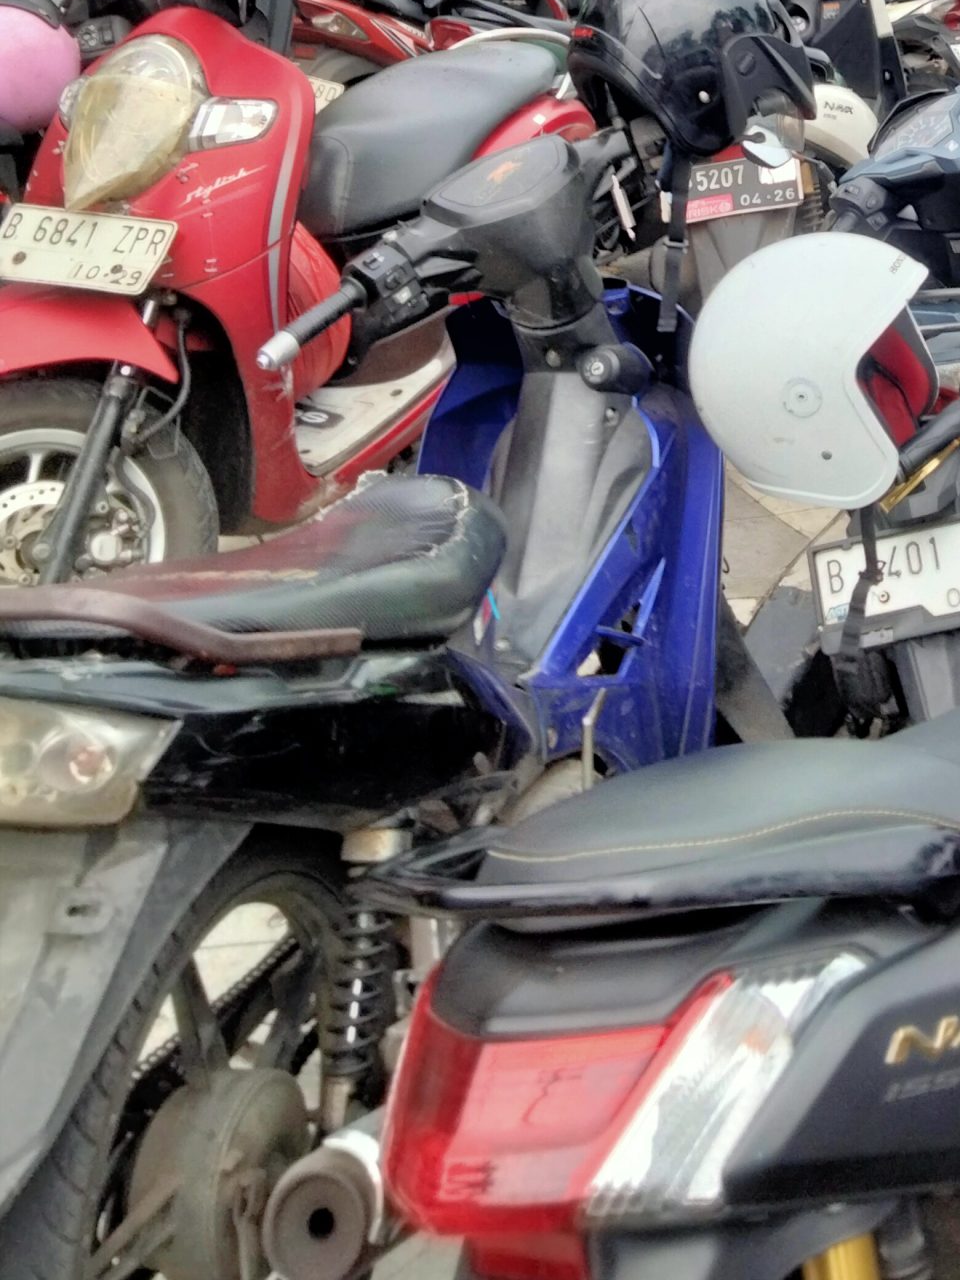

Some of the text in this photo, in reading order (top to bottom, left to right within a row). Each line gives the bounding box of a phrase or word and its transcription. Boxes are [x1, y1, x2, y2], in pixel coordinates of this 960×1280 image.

[696, 165, 744, 191] 5207
[3, 212, 166, 256] B 6841 ZPR
[827, 559, 844, 594] B
